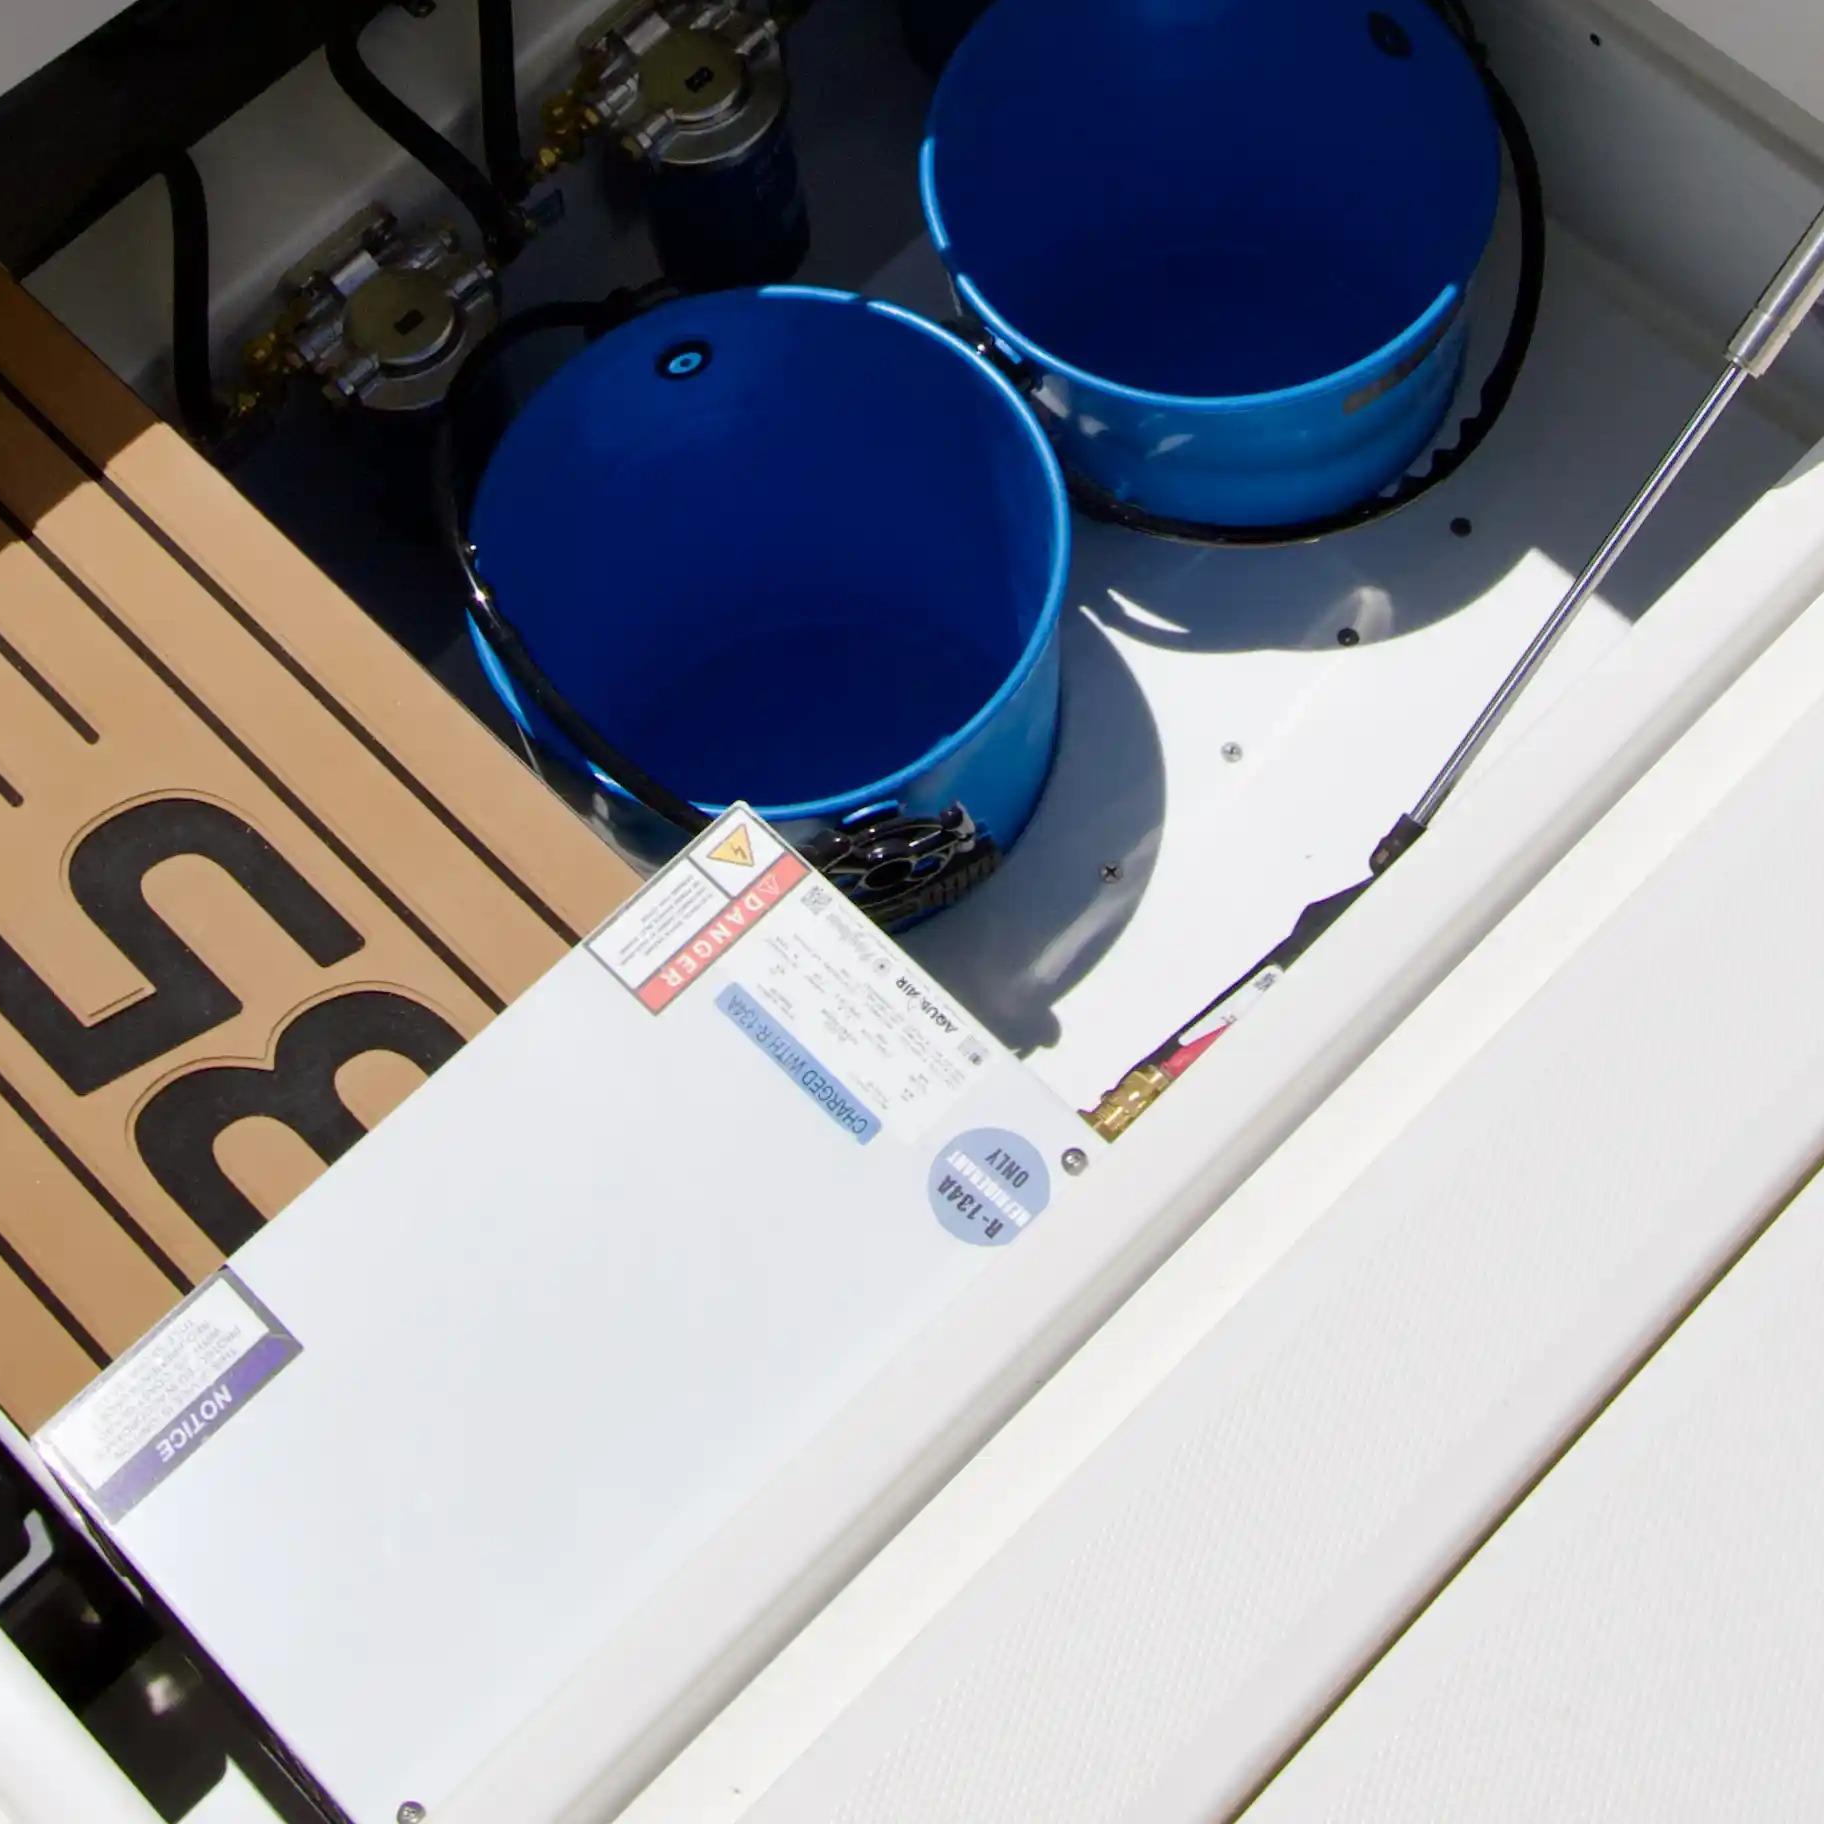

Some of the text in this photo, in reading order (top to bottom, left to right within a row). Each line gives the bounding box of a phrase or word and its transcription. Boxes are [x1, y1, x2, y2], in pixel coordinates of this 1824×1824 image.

[659, 890, 765, 989] DANGER
[722, 993, 775, 1045] R-134A
[764, 1034, 809, 1077] WITH
[798, 1066, 871, 1136] CHARGED
[984, 1146, 1030, 1189] ONLY
[935, 1174, 1004, 1239] R-134A
[153, 1383, 233, 1463] NOTICE
